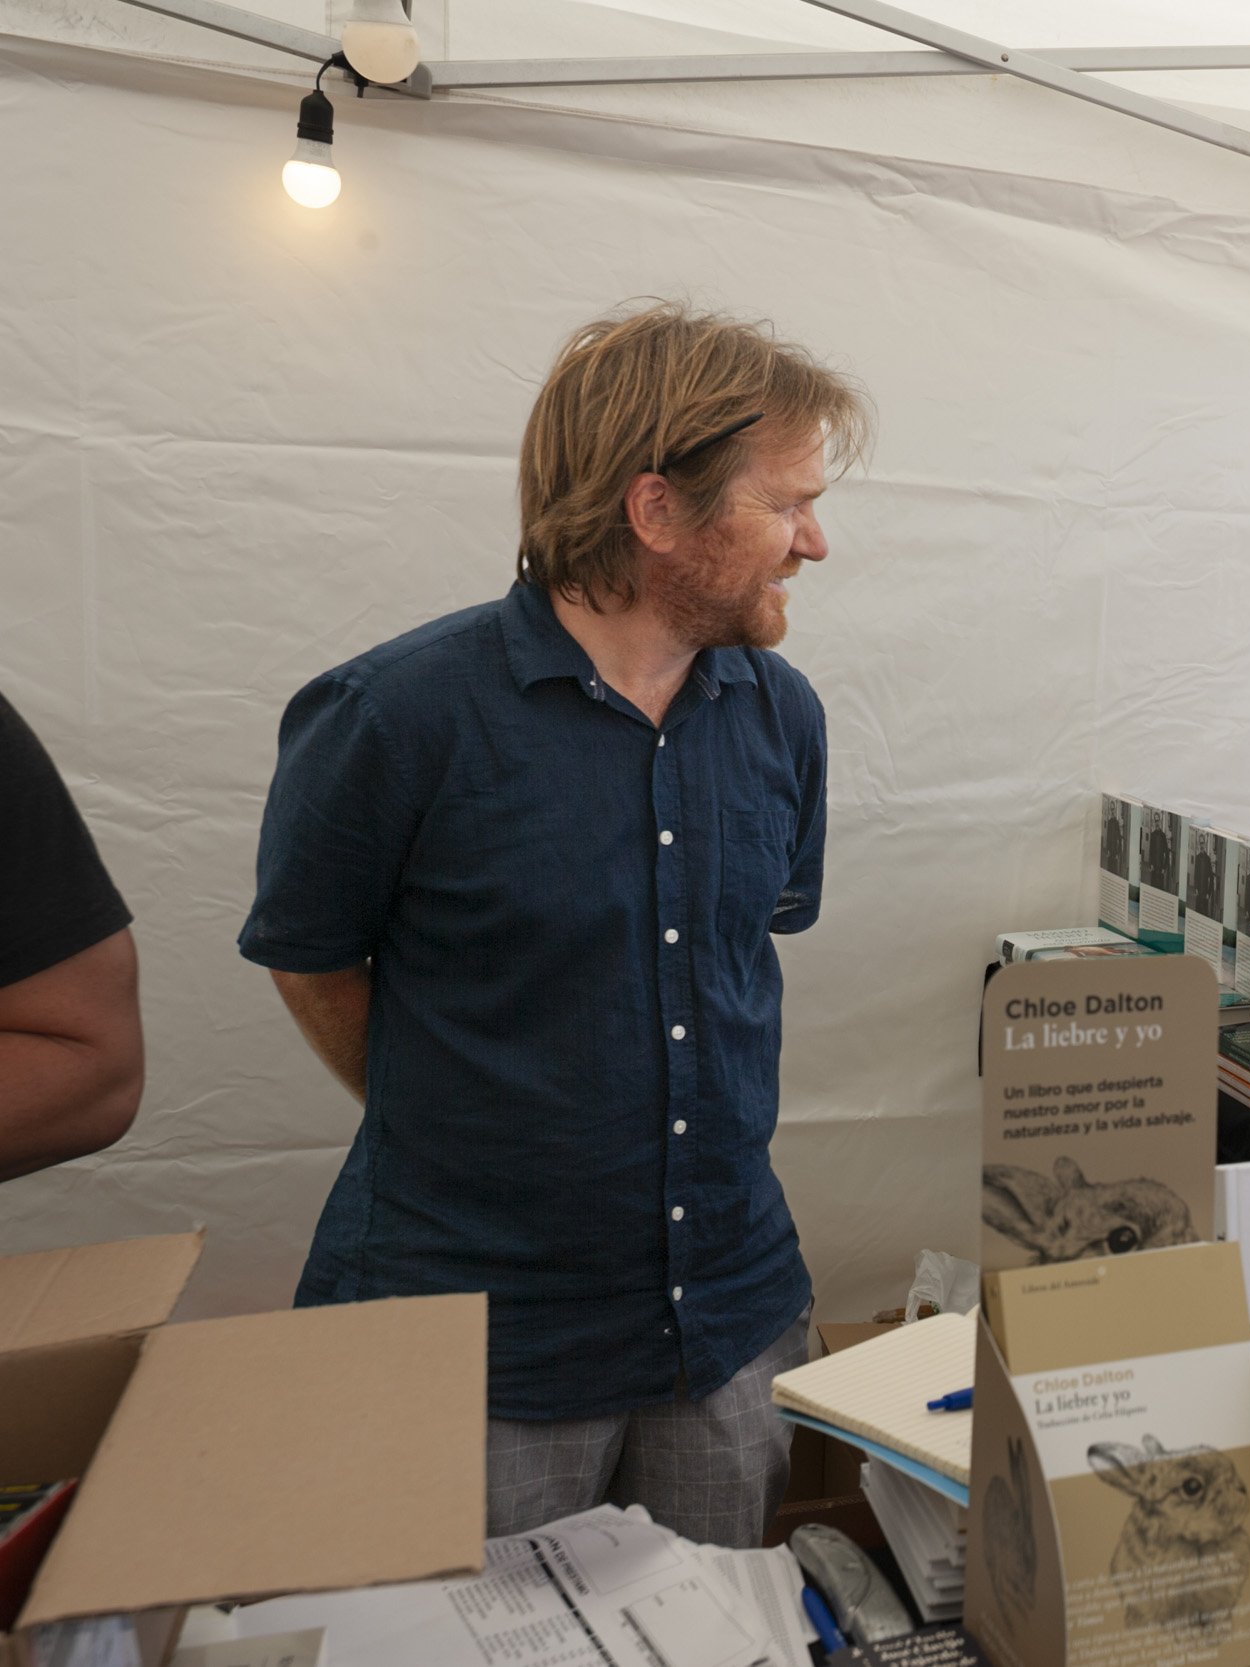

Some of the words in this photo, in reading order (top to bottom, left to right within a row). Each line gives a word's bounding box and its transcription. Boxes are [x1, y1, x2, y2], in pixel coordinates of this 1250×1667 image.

[1005, 997, 1076, 1019] Chloe
[1085, 993, 1163, 1015] Dalton
[1005, 1027, 1035, 1051] La
[1043, 1022, 1108, 1048] liebre
[1115, 1026, 1129, 1049] y
[1136, 1024, 1163, 1048] yo
[1004, 1087, 1024, 1100] Un
[1028, 1084, 1062, 1098] libro
[1066, 1082, 1093, 1096] que
[1097, 1076, 1164, 1093] despierta
[1003, 1104, 1060, 1120] nuestro
[1063, 1102, 1100, 1115] amor
[1104, 1099, 1129, 1113] por
[1133, 1096, 1146, 1109] la
[1003, 1123, 1080, 1140] naturaleza
[1083, 1122, 1093, 1135] y
[1095, 1117, 1109, 1131] la
[1111, 1115, 1142, 1130] vida
[1145, 1109, 1197, 1126] salvaje.
[1033, 1378, 1079, 1395] Chloe
[1082, 1369, 1134, 1388] Dalton
[1035, 1399, 1054, 1416] La
[1057, 1391, 1099, 1411] liebre
[1100, 1395, 1110, 1409] y
[1112, 1390, 1131, 1408] yo
